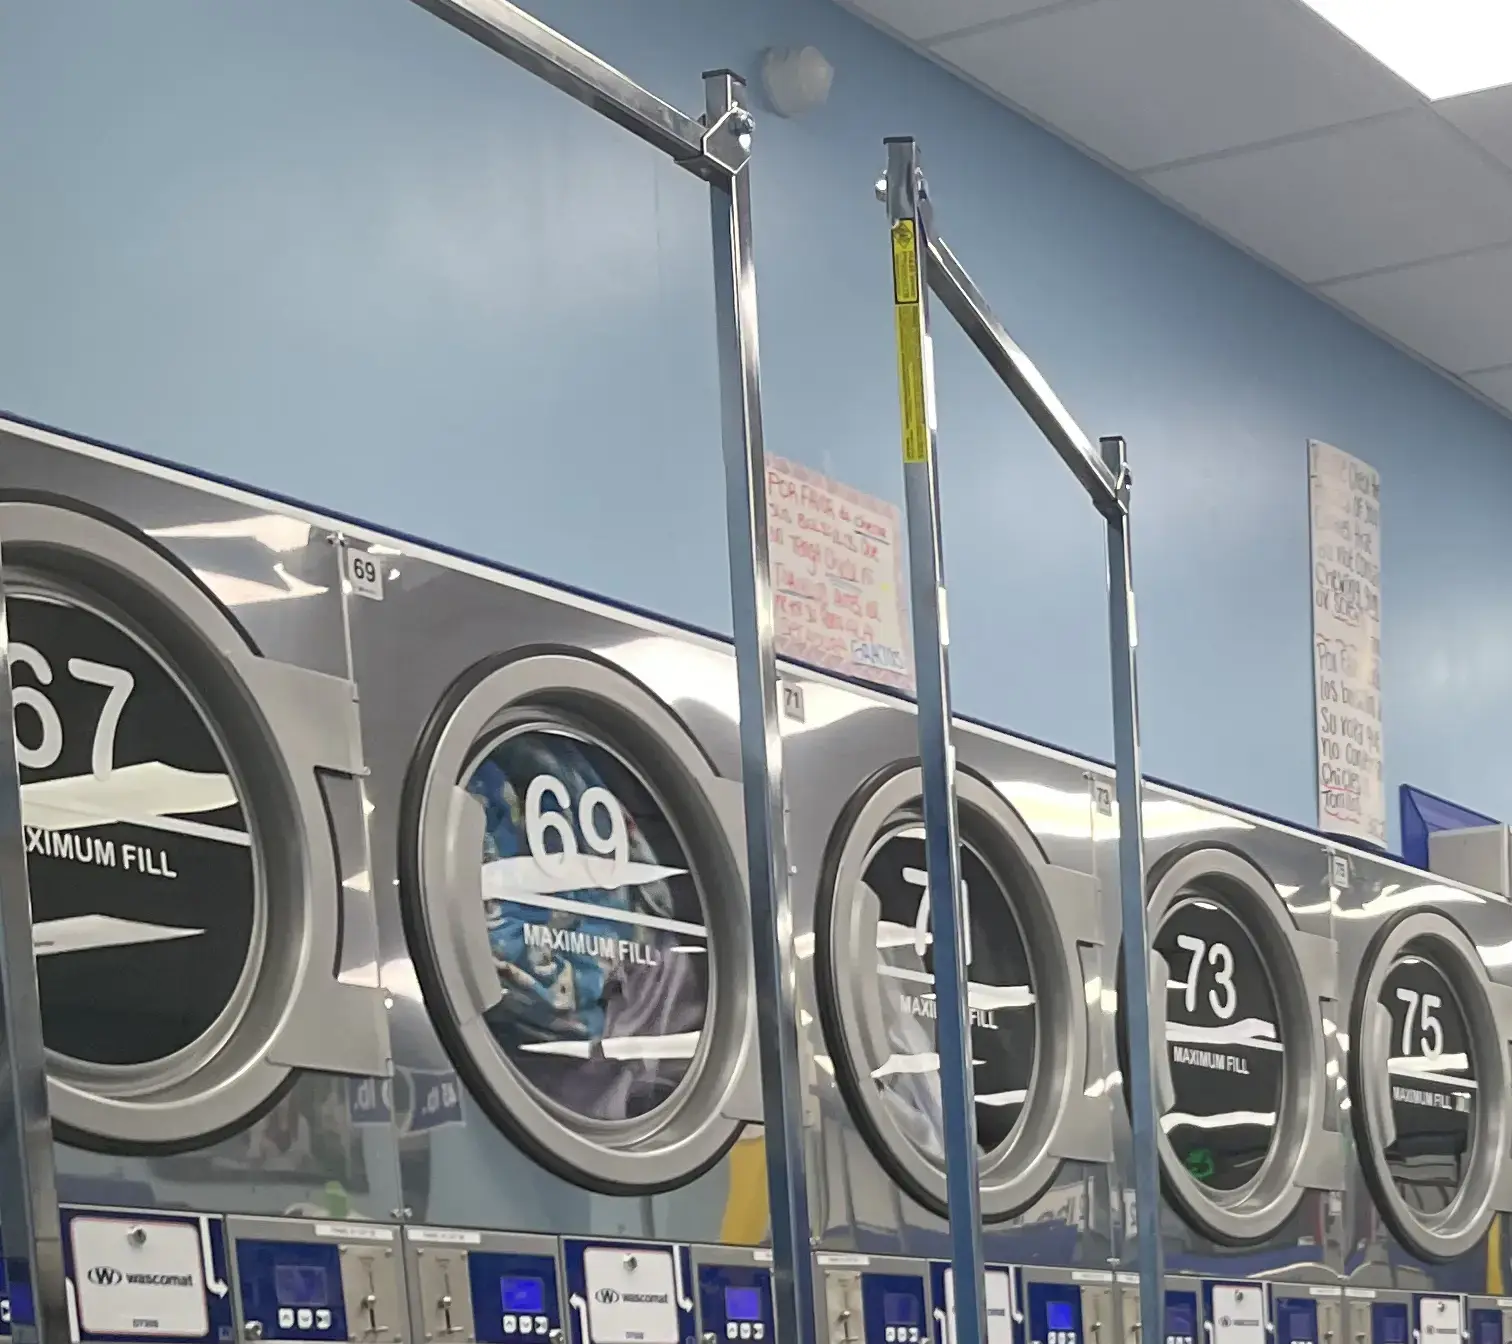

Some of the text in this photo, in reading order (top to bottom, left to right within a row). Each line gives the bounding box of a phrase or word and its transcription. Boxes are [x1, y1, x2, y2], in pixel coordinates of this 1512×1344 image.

[354, 558, 375, 582] 69
[8, 642, 134, 781] 67
[784, 688, 800, 708] 71
[525, 774, 629, 890] 69
[25, 826, 177, 879] XIMUM FILL
[524, 923, 657, 966] MAXIMUM FILL
[1177, 935, 1237, 1019] 73
[900, 995, 936, 1019] MAXI
[1397, 988, 1444, 1059] 75
[1174, 1046, 1250, 1075] MAXIMUM FILL
[126, 1273, 193, 1287] wascomat
[622, 1292, 668, 1304] wascomat
